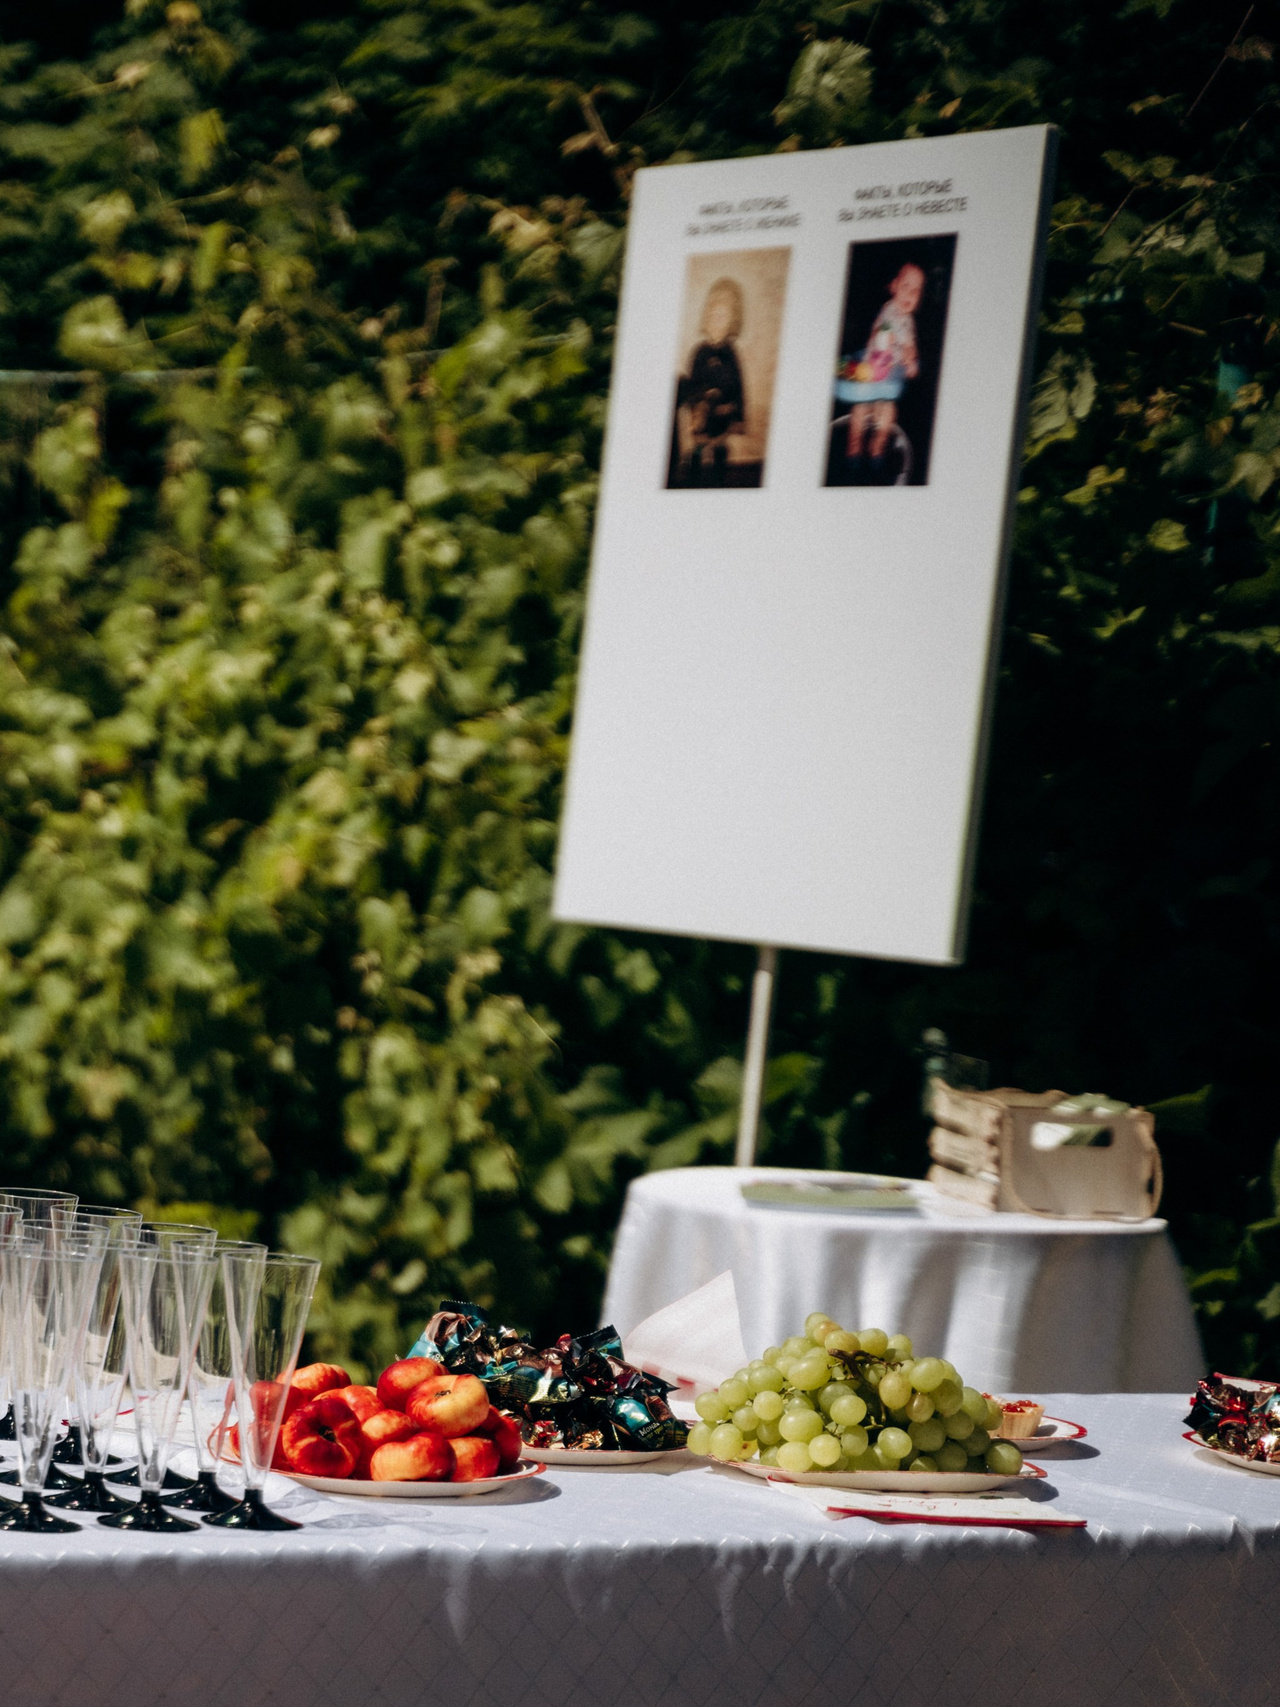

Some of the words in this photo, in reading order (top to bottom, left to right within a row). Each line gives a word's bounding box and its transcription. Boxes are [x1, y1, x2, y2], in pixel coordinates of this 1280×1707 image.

[897, 178, 952, 196] КОТОРЫЕ
[857, 203, 899, 220] ЗНАЕТЕ
[915, 196, 968, 214] НЕВЕСТЕ
